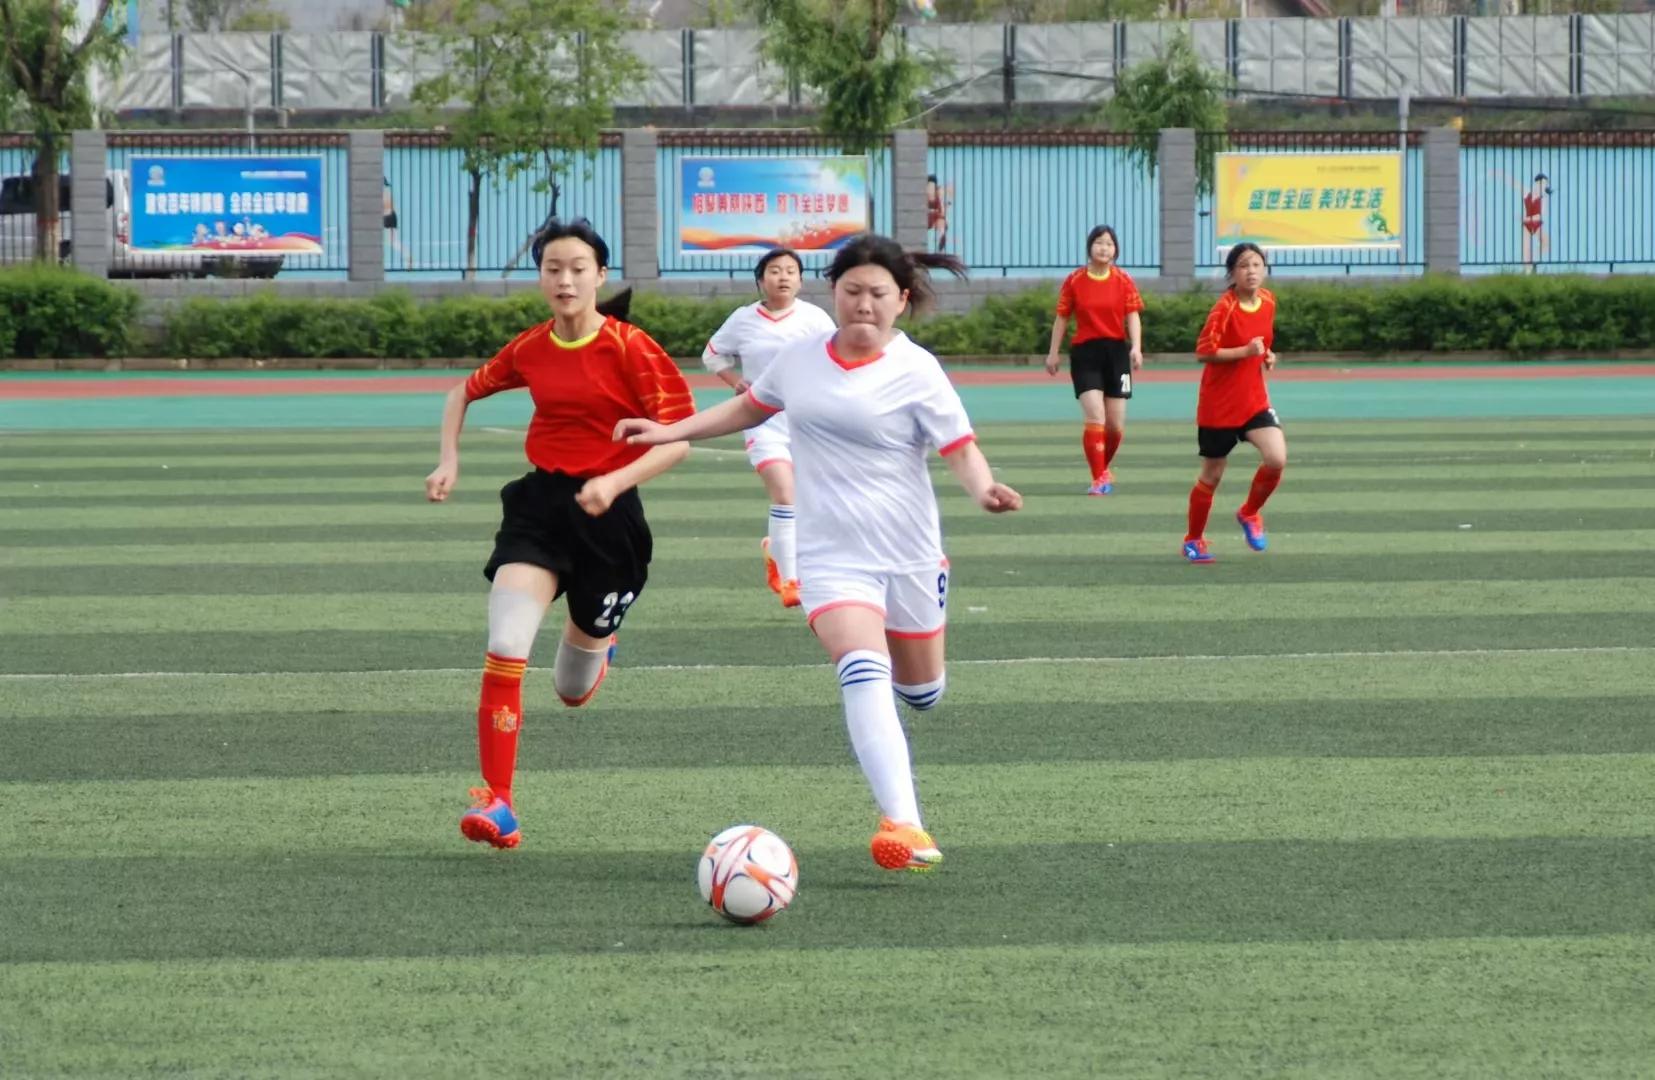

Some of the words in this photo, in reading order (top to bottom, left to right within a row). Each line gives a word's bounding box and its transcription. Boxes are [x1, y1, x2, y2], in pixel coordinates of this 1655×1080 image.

[1248, 187, 1314, 210] 盛世全运
[1318, 187, 1385, 210] 美好生活
[593, 591, 634, 628] 23
